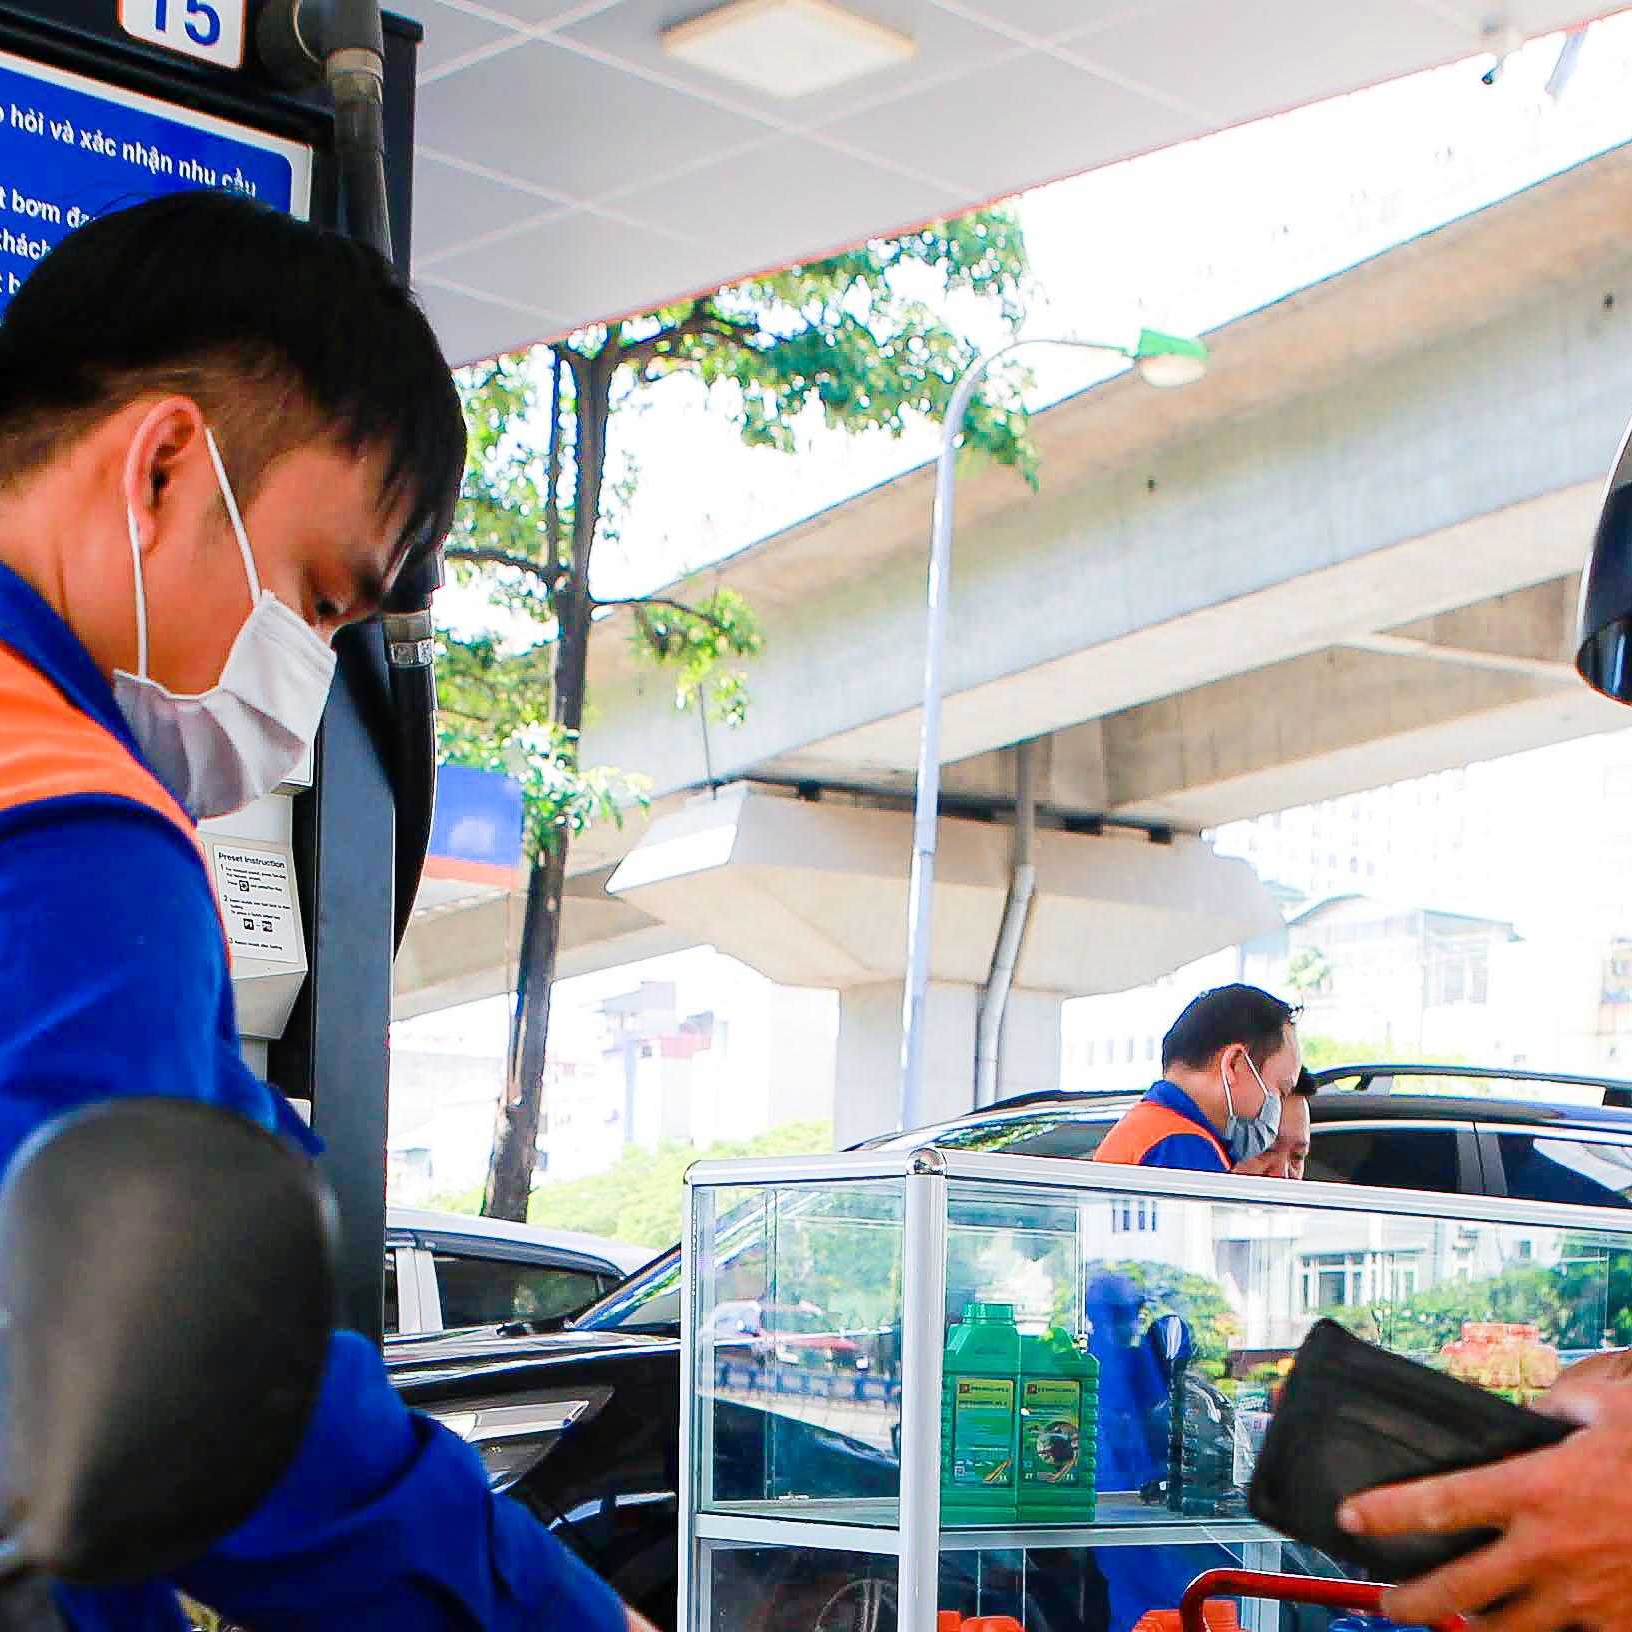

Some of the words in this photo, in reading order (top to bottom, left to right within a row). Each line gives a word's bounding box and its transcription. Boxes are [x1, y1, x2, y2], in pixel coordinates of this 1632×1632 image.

[49, 119, 74, 145] và
[79, 129, 117, 157] xác
[122, 141, 173, 175] nhận
[178, 159, 216, 186] nhu
[11, 188, 61, 225] bơm
